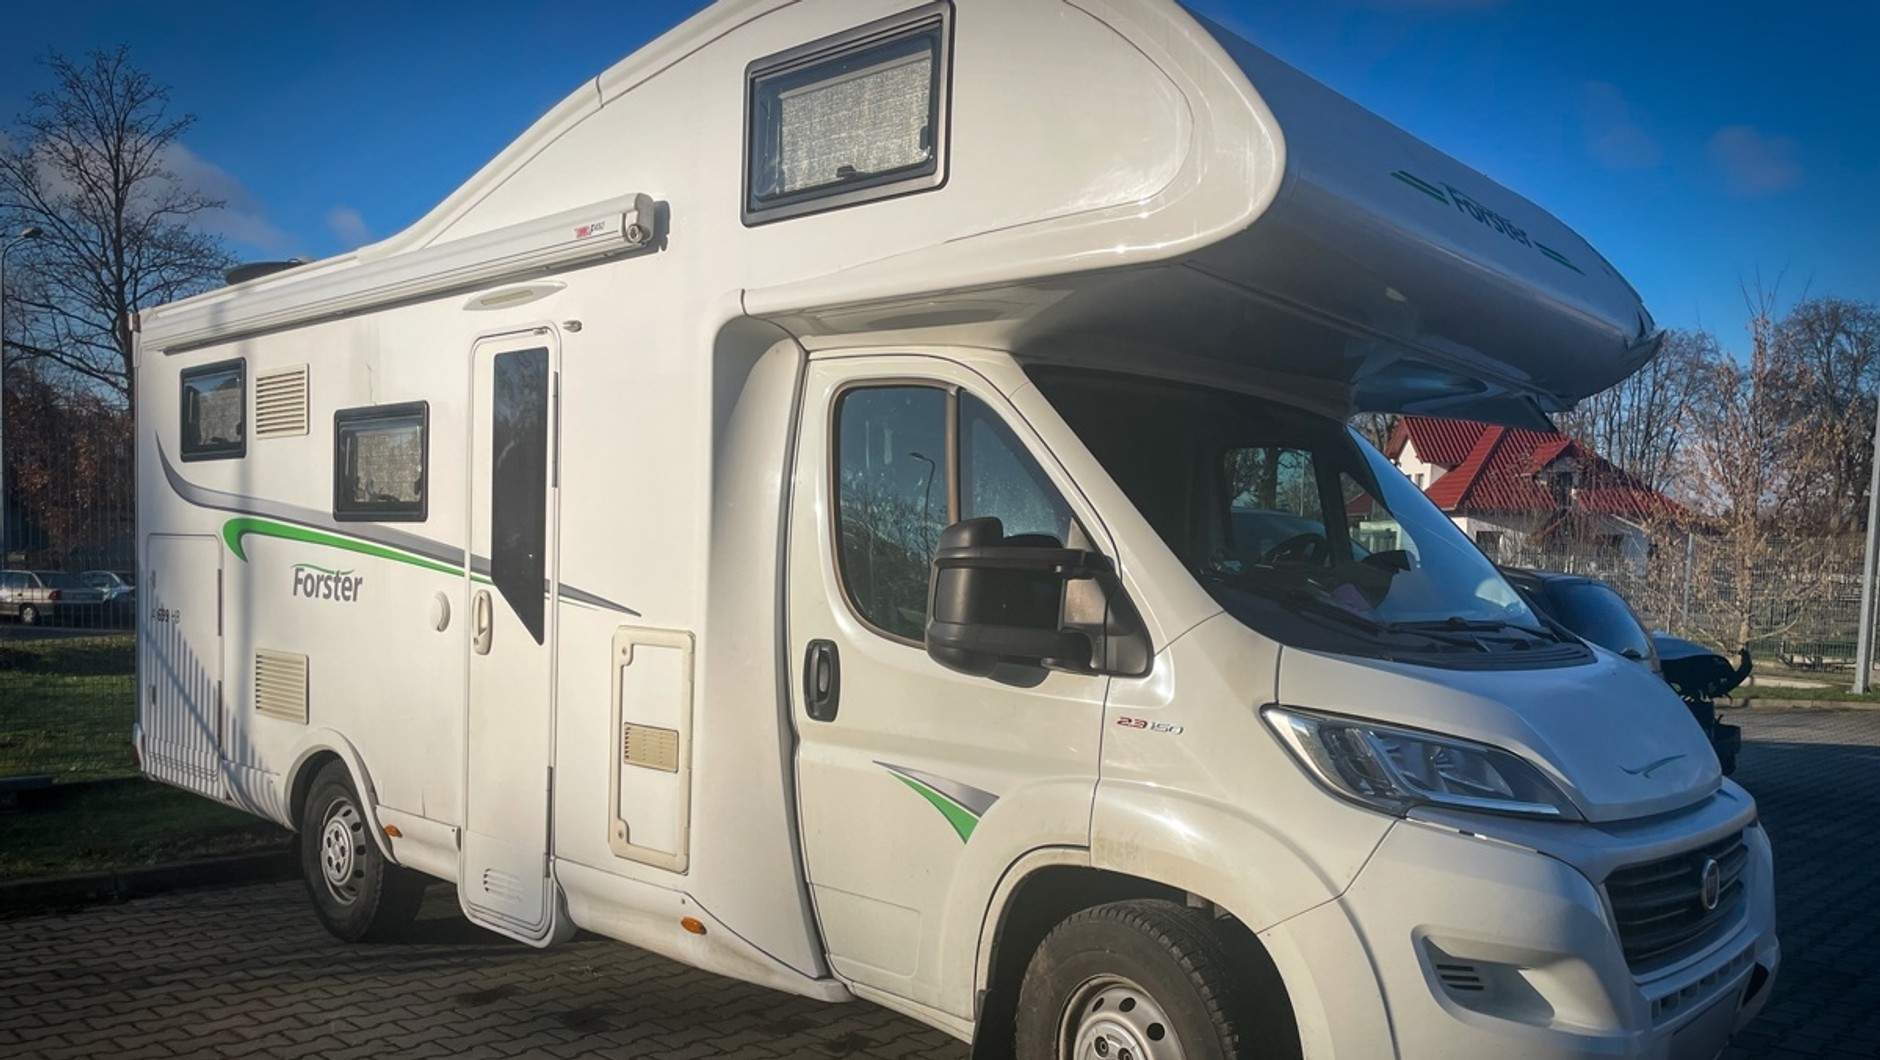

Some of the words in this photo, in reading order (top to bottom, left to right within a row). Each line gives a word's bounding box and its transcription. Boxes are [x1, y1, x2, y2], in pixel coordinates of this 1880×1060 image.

[1444, 184, 1533, 248] Forster
[293, 567, 363, 602] Forster
[1150, 722, 1184, 735] 150
